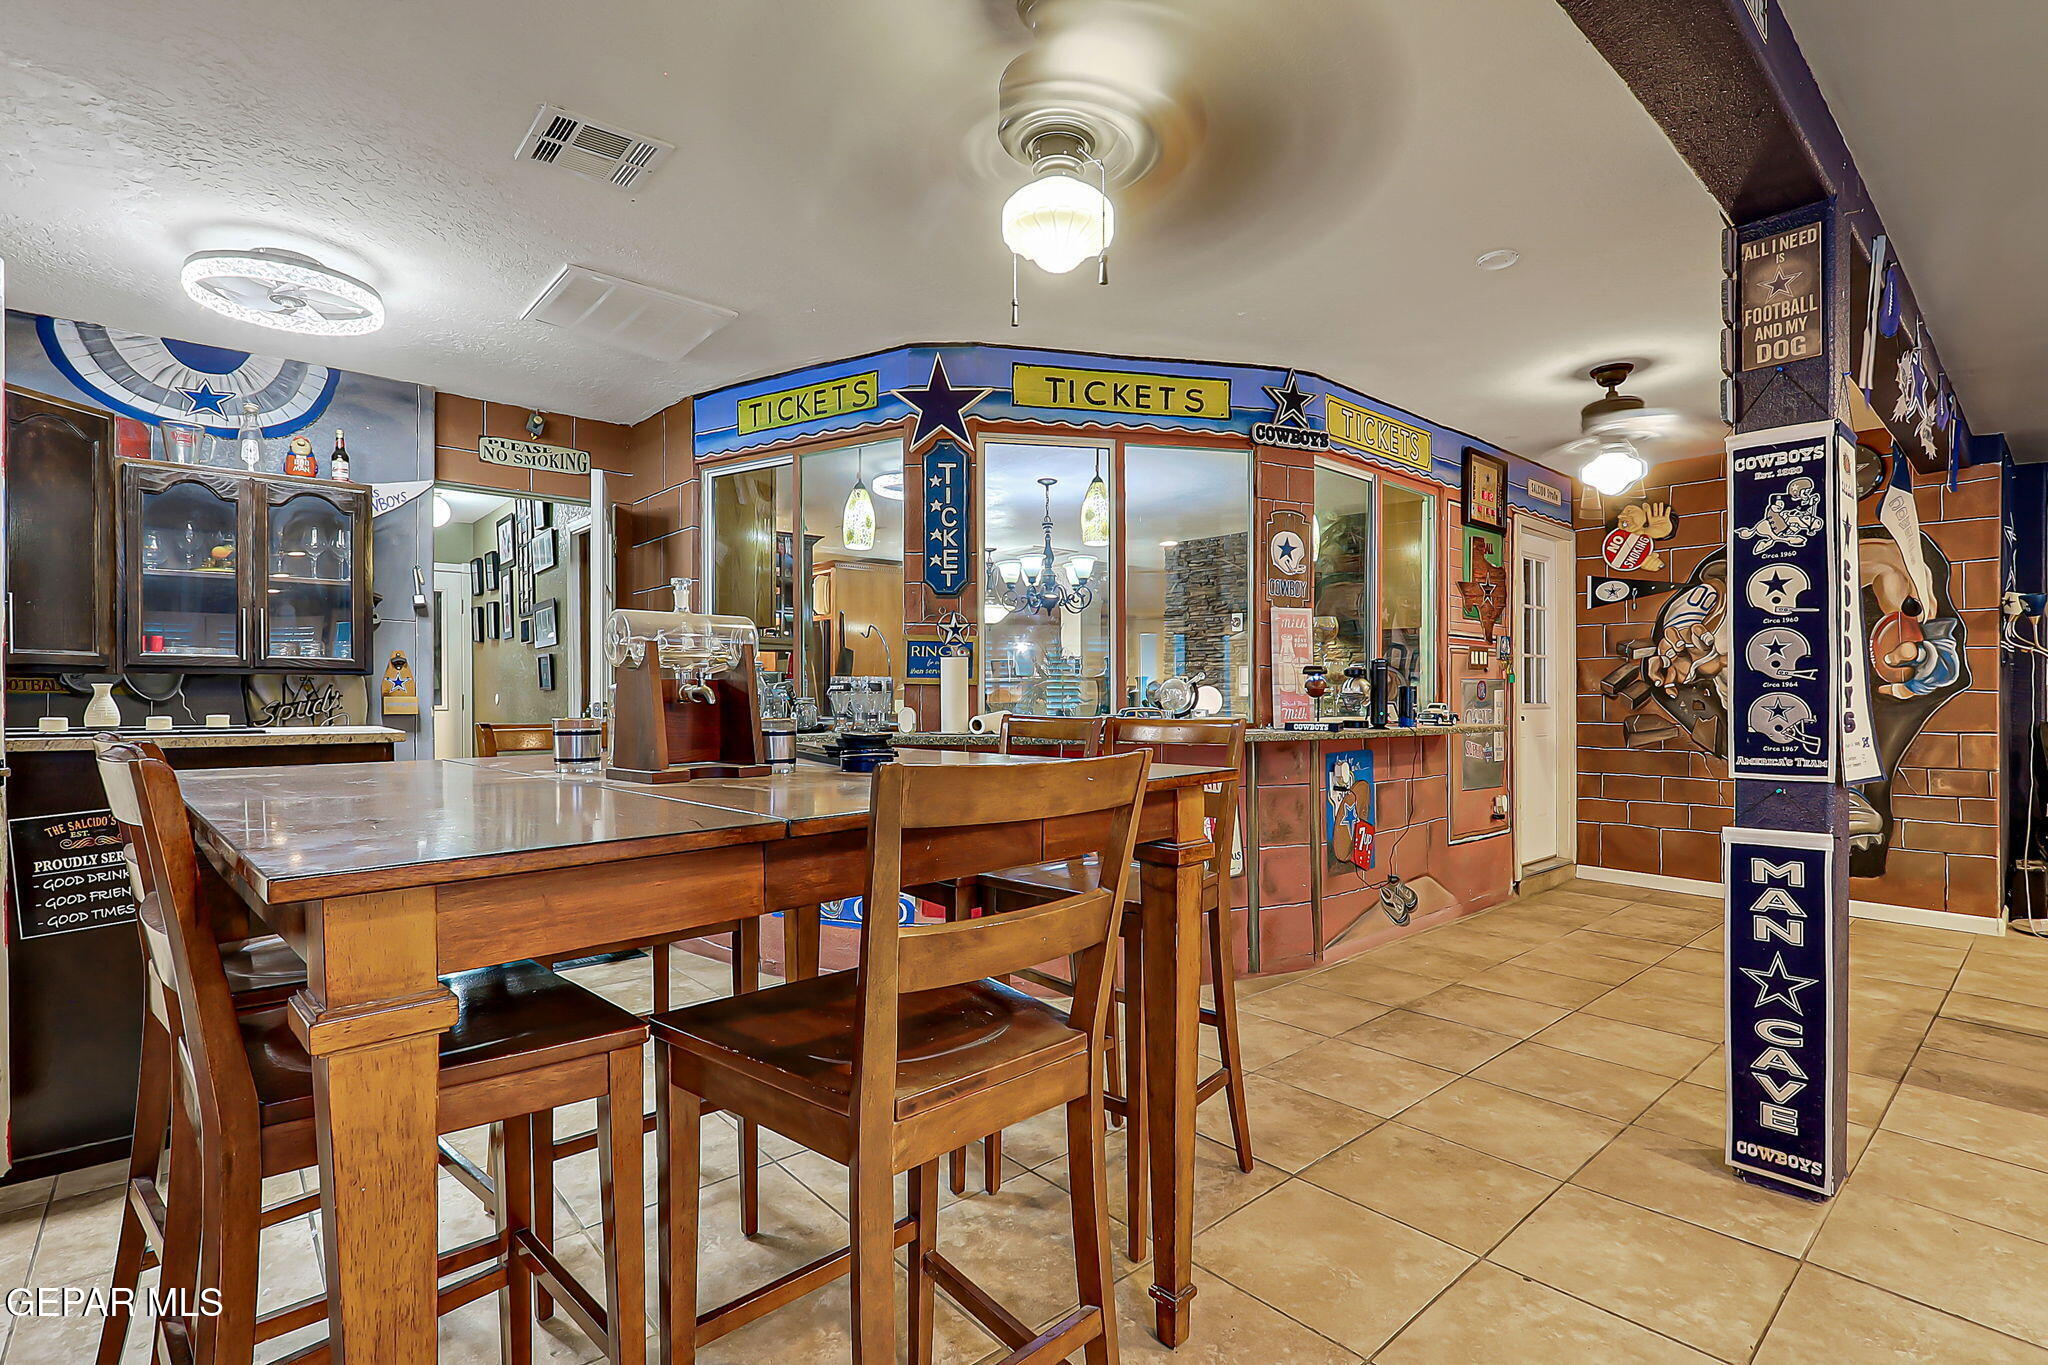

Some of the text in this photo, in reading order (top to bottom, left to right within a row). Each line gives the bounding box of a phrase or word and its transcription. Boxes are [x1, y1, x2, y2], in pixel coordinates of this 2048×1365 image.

[1744, 228, 1817, 261] ALL I NEED
[1776, 252, 1785, 264] IS
[1744, 293, 1818, 327] FOOTBALL
[1755, 315, 1808, 342] AND MY
[1757, 335, 1807, 364] DOG
[749, 380, 869, 427] TICKETS
[1045, 377, 1204, 413] TICKETS
[488, 439, 552, 454] PLEASE
[1255, 425, 1329, 448] COWBOYS
[1342, 408, 1420, 461] TICKETS
[483, 445, 587, 473] NO SMOKING
[1735, 444, 1824, 472] COWBOYS
[938, 463, 958, 587] TICKET
[1607, 535, 1624, 554] NO
[1624, 535, 1649, 568] SMOKING
[1269, 578, 1307, 598] COWBOY
[44, 815, 117, 838] THE SALCIDO'S
[70, 830, 90, 838] EST.
[34, 854, 98, 873] PROUDLY
[43, 876, 84, 891] GOOD
[45, 894, 87, 910] GOOD
[47, 904, 136, 928] GOOD TIMES
[1750, 857, 1808, 947] MAN
[1750, 1019, 1809, 1136] CAVE
[1736, 1140, 1823, 1177] COWBOYS
